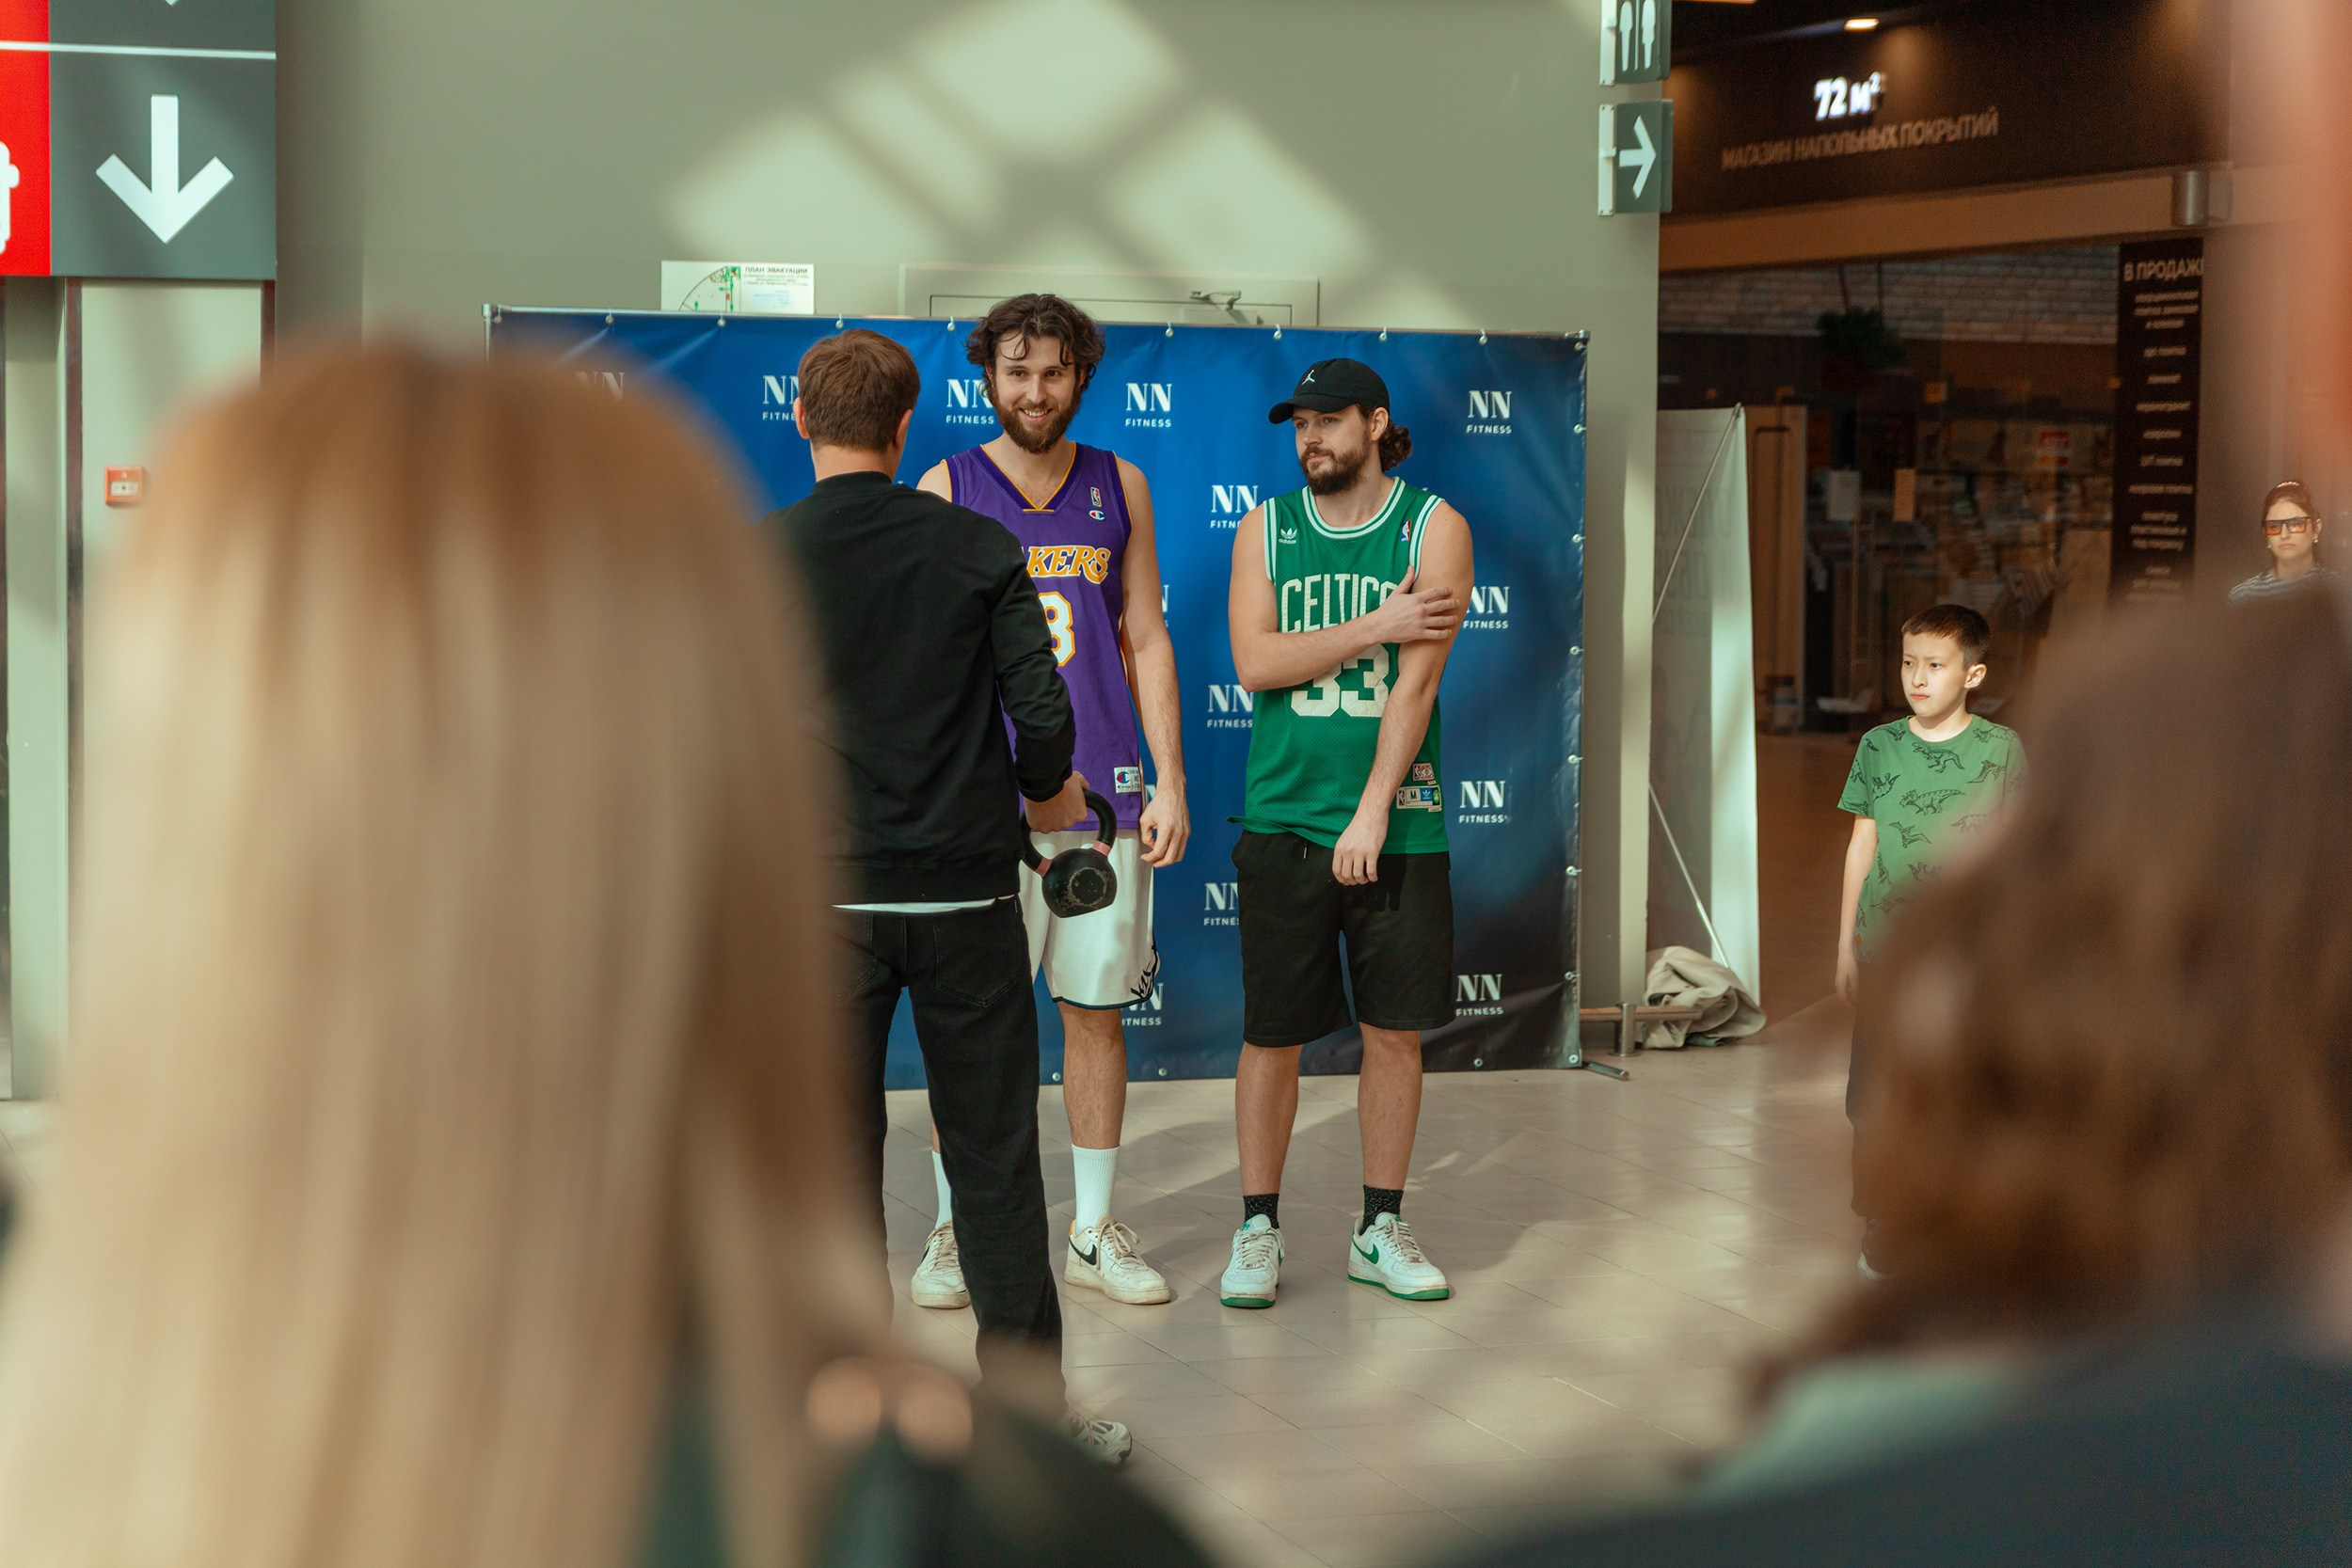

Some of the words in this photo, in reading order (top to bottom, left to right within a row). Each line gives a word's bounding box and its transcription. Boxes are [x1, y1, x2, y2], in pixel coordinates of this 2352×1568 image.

[1815, 76, 1848, 121] 72
[1721, 141, 1792, 170] МАГАЗИН
[1900, 105, 1999, 148] ПОКРЫТИЙ
[2137, 258, 2203, 281] ПРОДАЖ
[1126, 382, 1172, 411] NN
[1468, 389, 1513, 419] NN
[762, 411, 797, 421] FITNE
[946, 415, 994, 424] FITNESS
[1124, 418, 1172, 428] FITNESS
[1466, 424, 1513, 435] FITNESS
[1211, 484, 1259, 513] NN
[1210, 519, 1241, 529] FITN
[1021, 545, 1111, 584] KERS
[1467, 585, 1510, 613] NN
[1462, 620, 1509, 629] FITNESS
[1208, 684, 1253, 712] NN
[1206, 719, 1253, 729] FITNESS
[1459, 781, 1506, 808] NN
[1458, 814, 1505, 824] FITNESS
[1203, 917, 1240, 927] FITNE
[1129, 983, 1164, 1011] N
[1456, 974, 1502, 1002] NN
[1121, 1018, 1162, 1026] ITNESS
[1455, 1006, 1503, 1017] FITNESS
